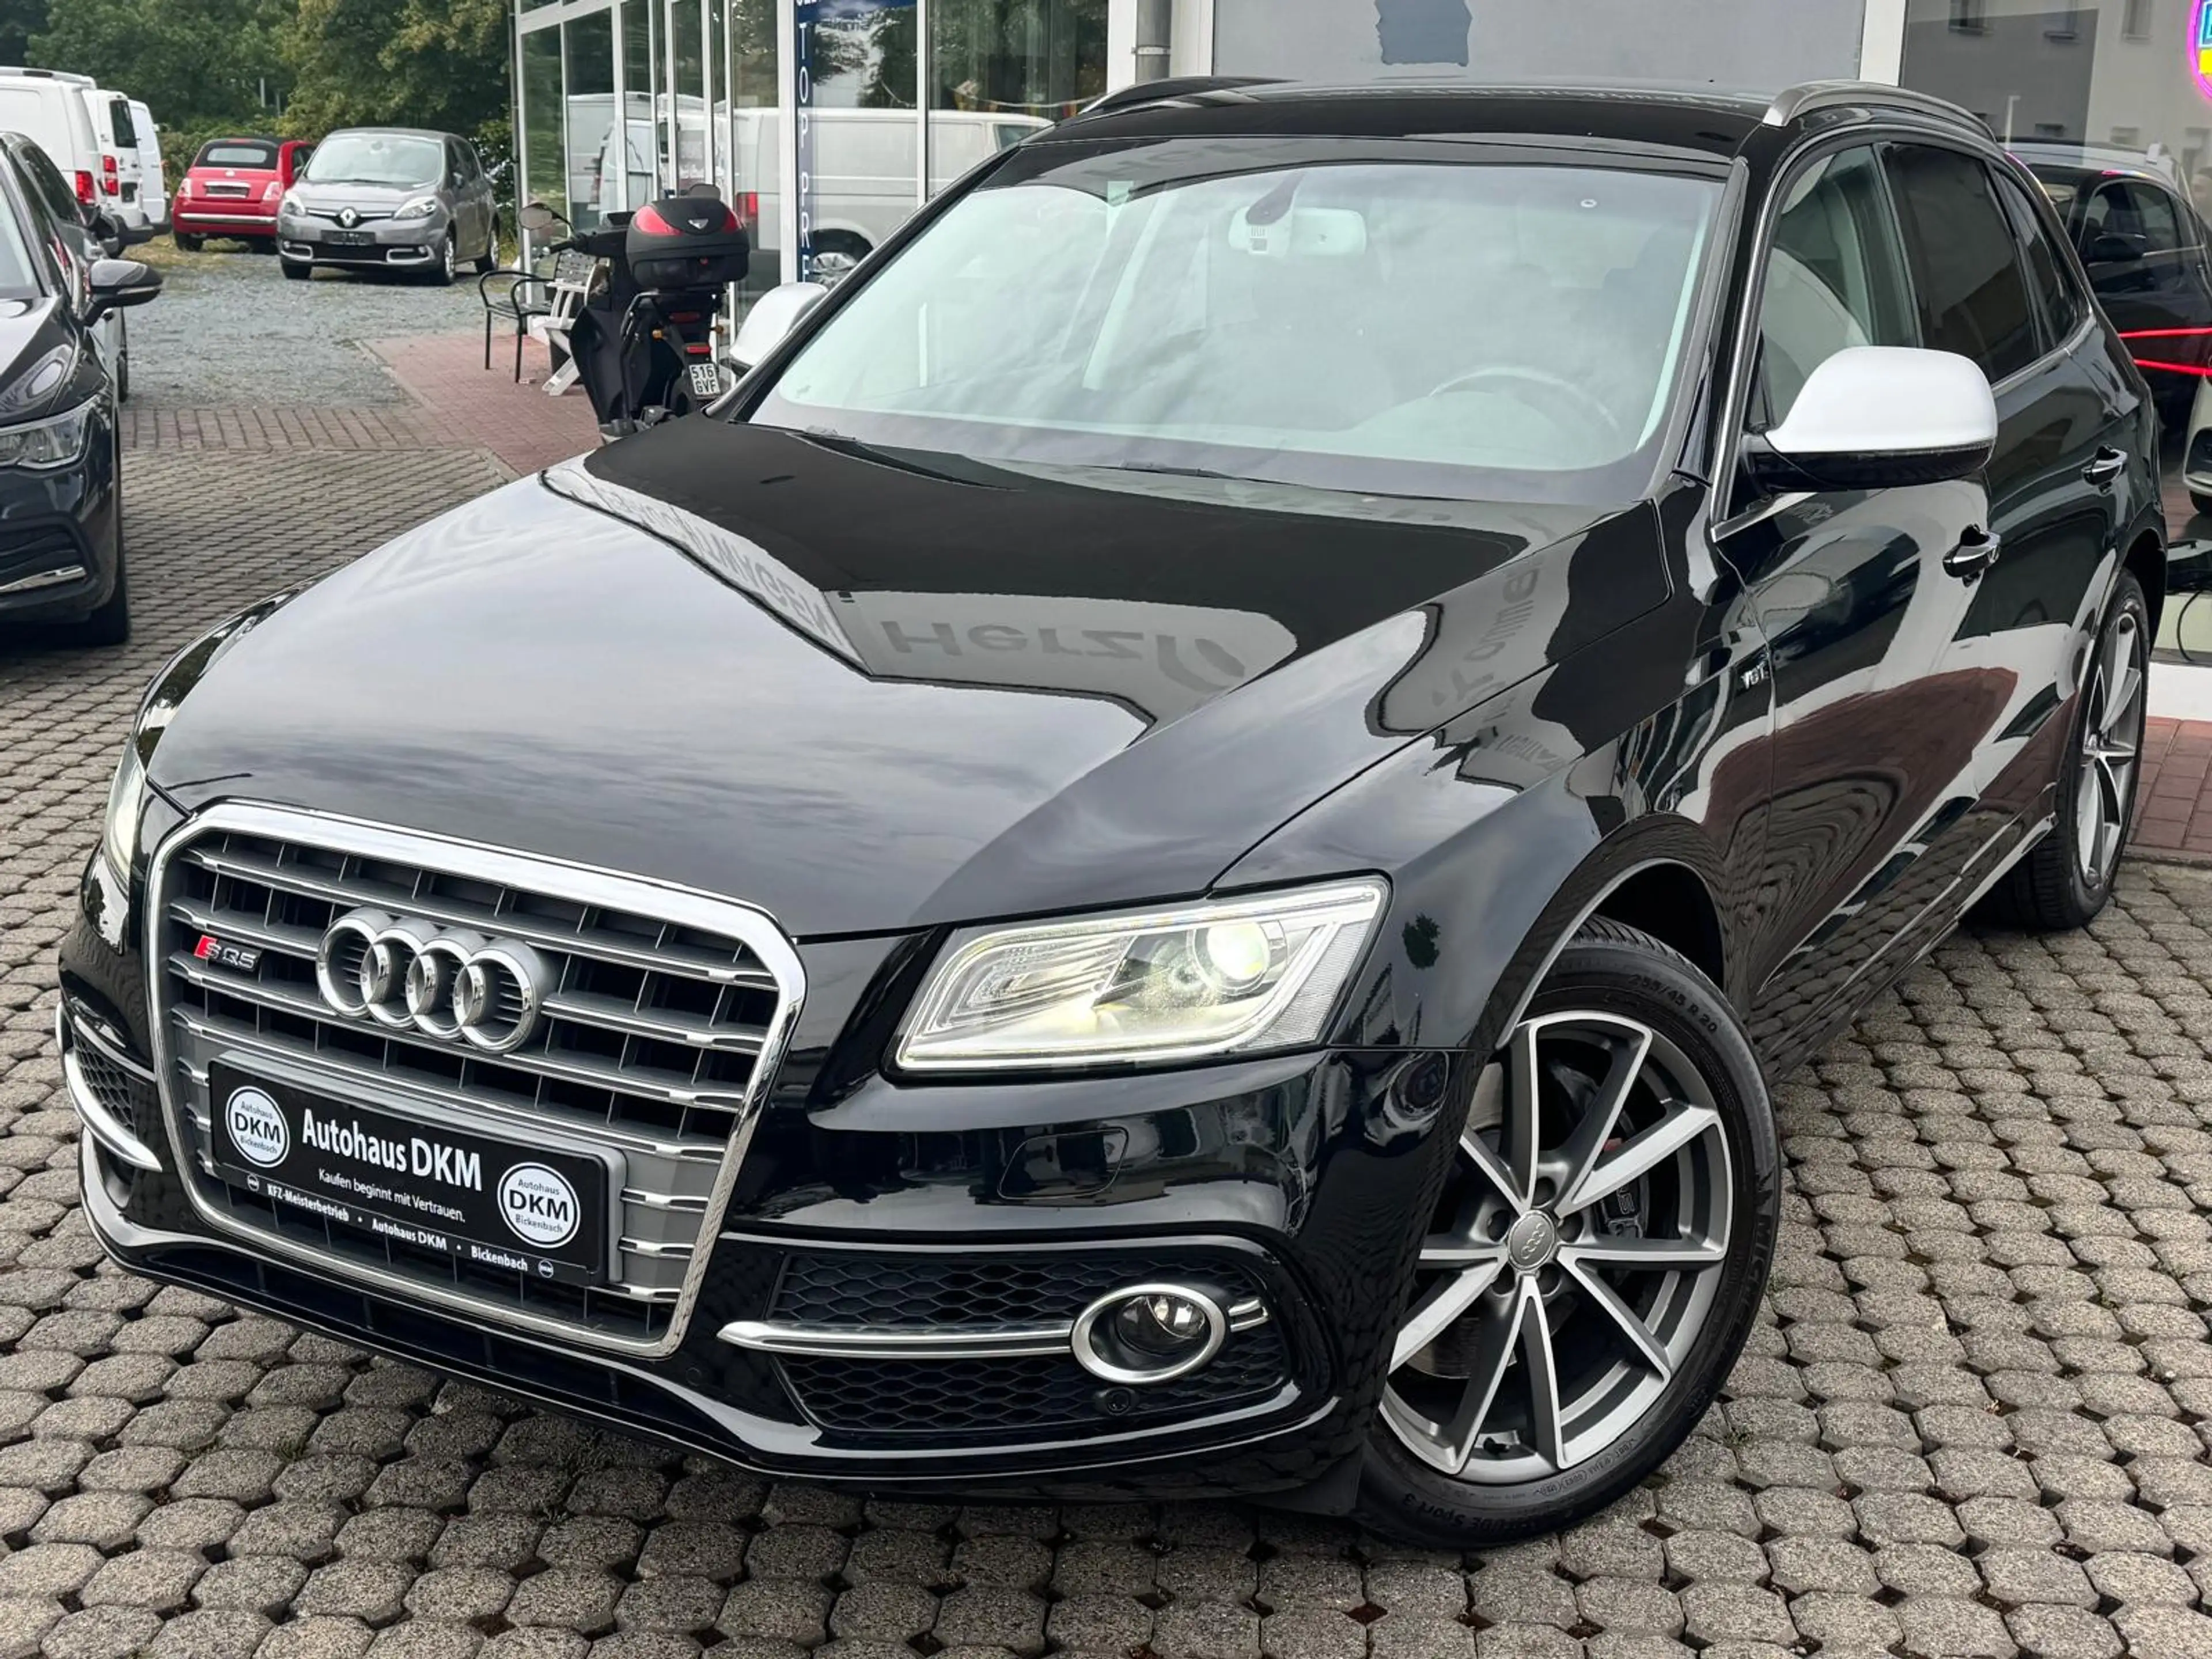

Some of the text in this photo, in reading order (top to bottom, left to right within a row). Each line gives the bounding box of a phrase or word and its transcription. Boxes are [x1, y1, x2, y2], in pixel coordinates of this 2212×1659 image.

[798, 22, 810, 149] TOP
[691, 365, 714, 378] 516
[240, 1101, 273, 1120] Autohaus
[234, 1112, 281, 1144] DKM
[302, 1108, 482, 1191] Autohaus DKM
[318, 1168, 466, 1223] Kaufen beginnt mit Vertrauen.
[518, 1179, 560, 1195] Autohaus
[509, 1190, 569, 1222] DKM
[267, 1183, 350, 1223] KFZ-Meisterbetrieb
[371, 1217, 418, 1246] Autohaus
[418, 1229, 448, 1252] DKM
[470, 1245, 528, 1272] Bickenbach
[515, 1214, 563, 1233] Bickenbach
